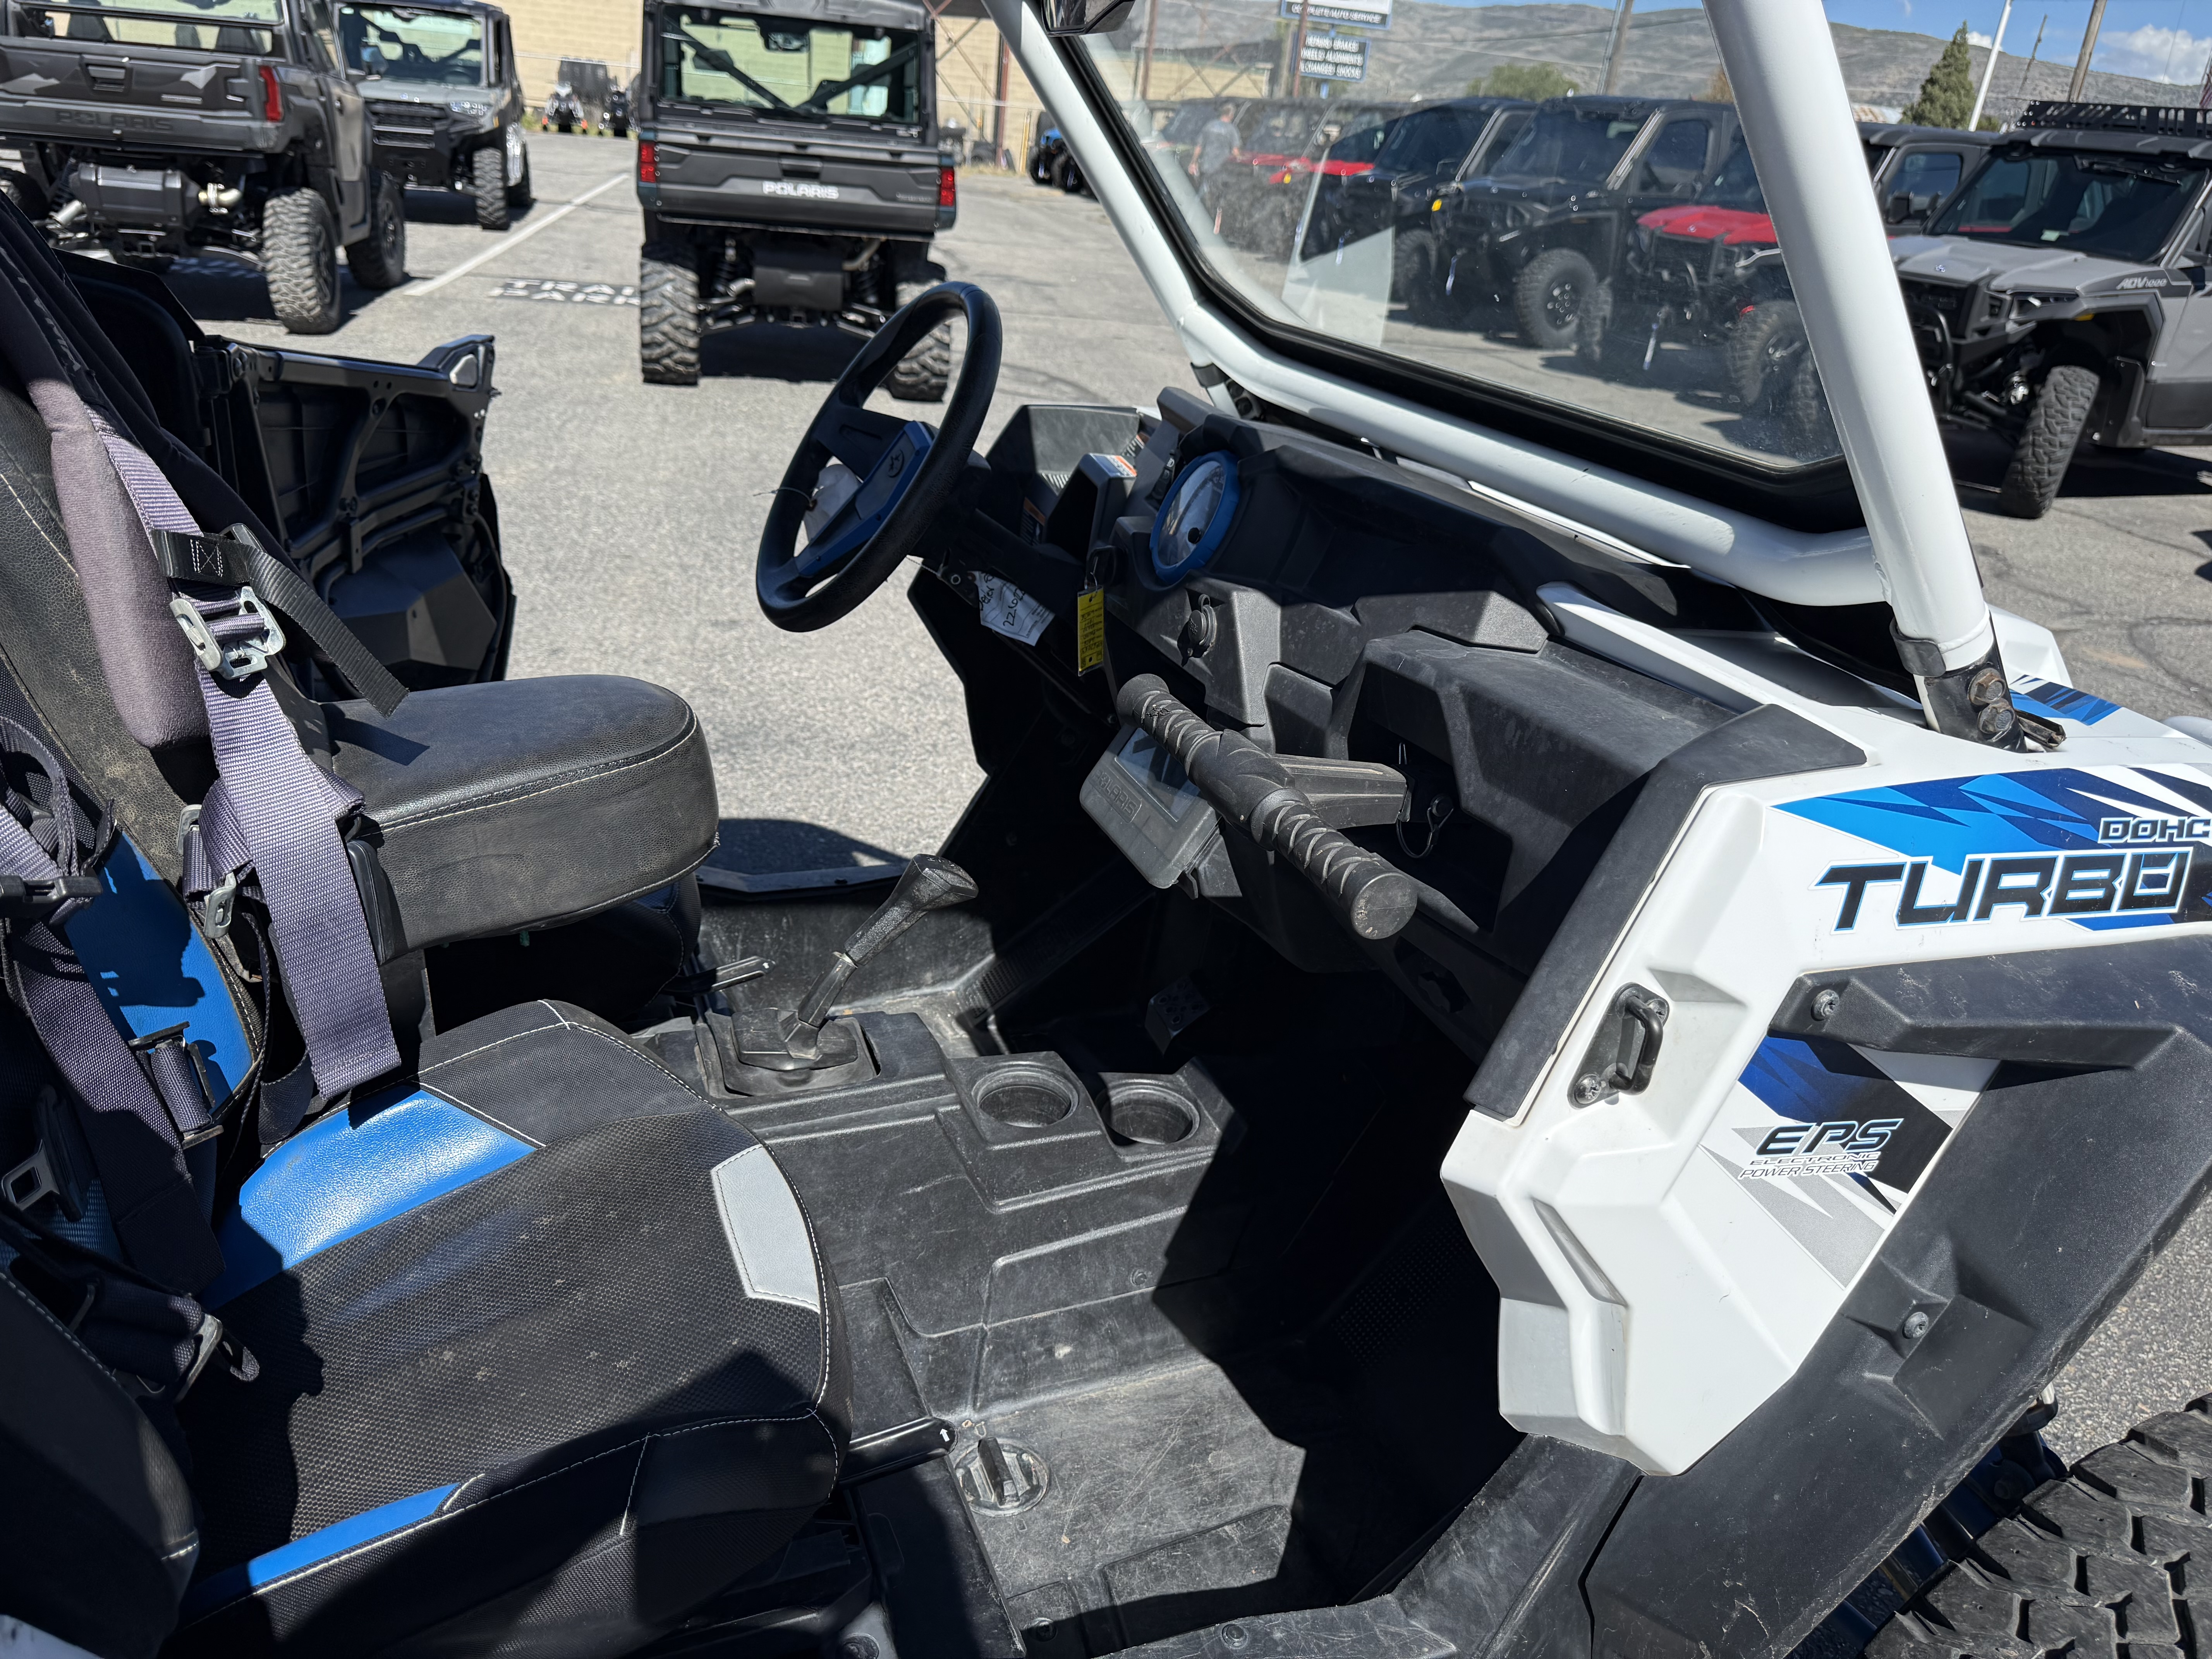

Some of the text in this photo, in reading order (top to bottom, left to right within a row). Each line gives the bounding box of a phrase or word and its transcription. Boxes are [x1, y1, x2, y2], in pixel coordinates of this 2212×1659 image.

[1291, 3, 1329, 17] COPLETE
[57, 111, 173, 131] POLARIS
[763, 181, 839, 199] POLARIS
[1092, 769, 1138, 817] POLARIS
[2099, 817, 2212, 843] DOHC
[1815, 852, 2190, 931] TURBO
[1756, 1118, 1904, 1158] EPS
[1749, 1152, 1881, 1165] ELECTRONIC
[1739, 1161, 1877, 1178] POWER STEERING
